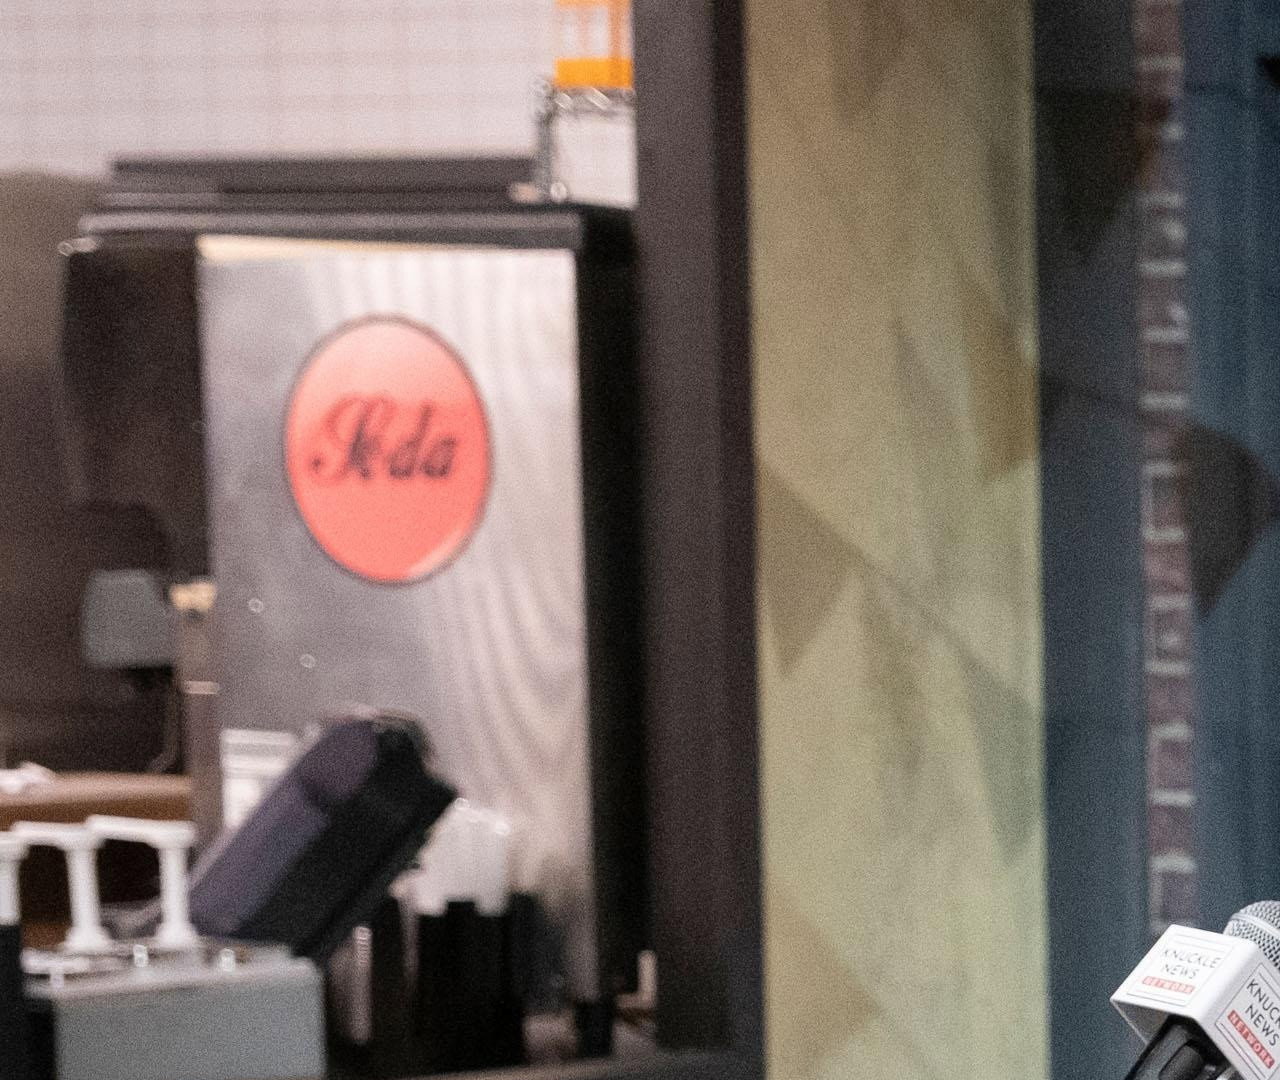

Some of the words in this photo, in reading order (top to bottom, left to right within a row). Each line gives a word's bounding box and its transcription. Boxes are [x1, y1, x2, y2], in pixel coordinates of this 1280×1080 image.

[1160, 948, 1222, 968] KNUCKLE
[1161, 963, 1199, 979] NEWS
[1227, 1010, 1275, 1069] NETWORK
[1245, 1004, 1280, 1047] NEWS
